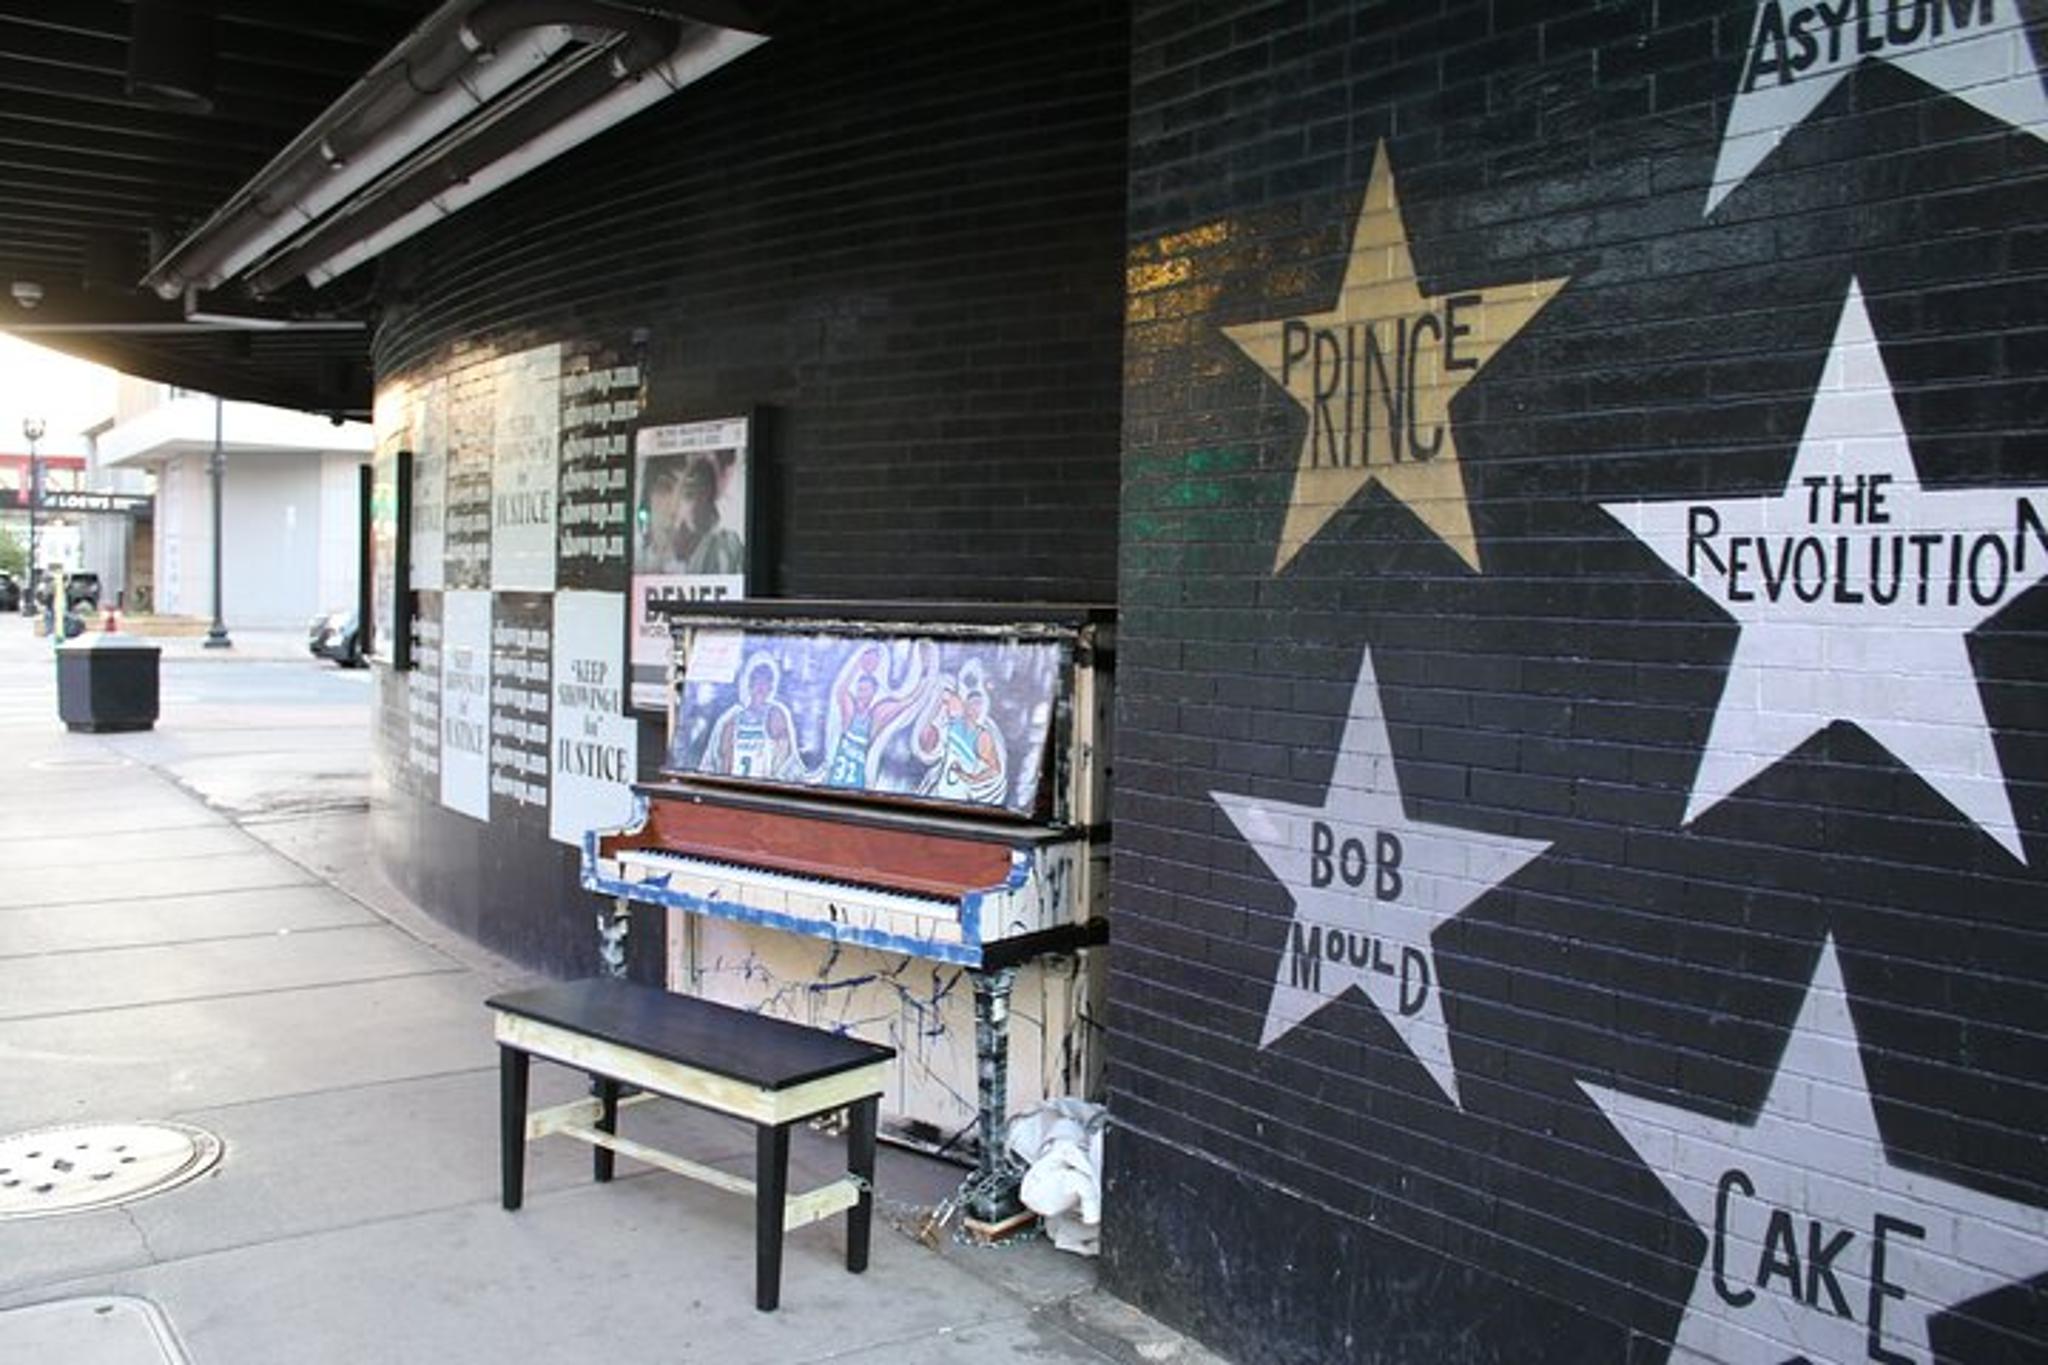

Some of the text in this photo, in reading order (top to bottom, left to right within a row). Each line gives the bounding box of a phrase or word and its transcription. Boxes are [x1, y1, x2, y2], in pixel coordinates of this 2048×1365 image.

[1742, 0, 1995, 94] ASYLUM
[1282, 295, 1482, 468] PRINCE
[1802, 474, 1892, 524] THE
[1687, 497, 2048, 606] REVOLUTION
[557, 736, 629, 785] JUSTICE
[1311, 821, 1403, 902] BOB
[1291, 921, 1430, 1017] MOULD
[1712, 1169, 1926, 1365] CAKE
